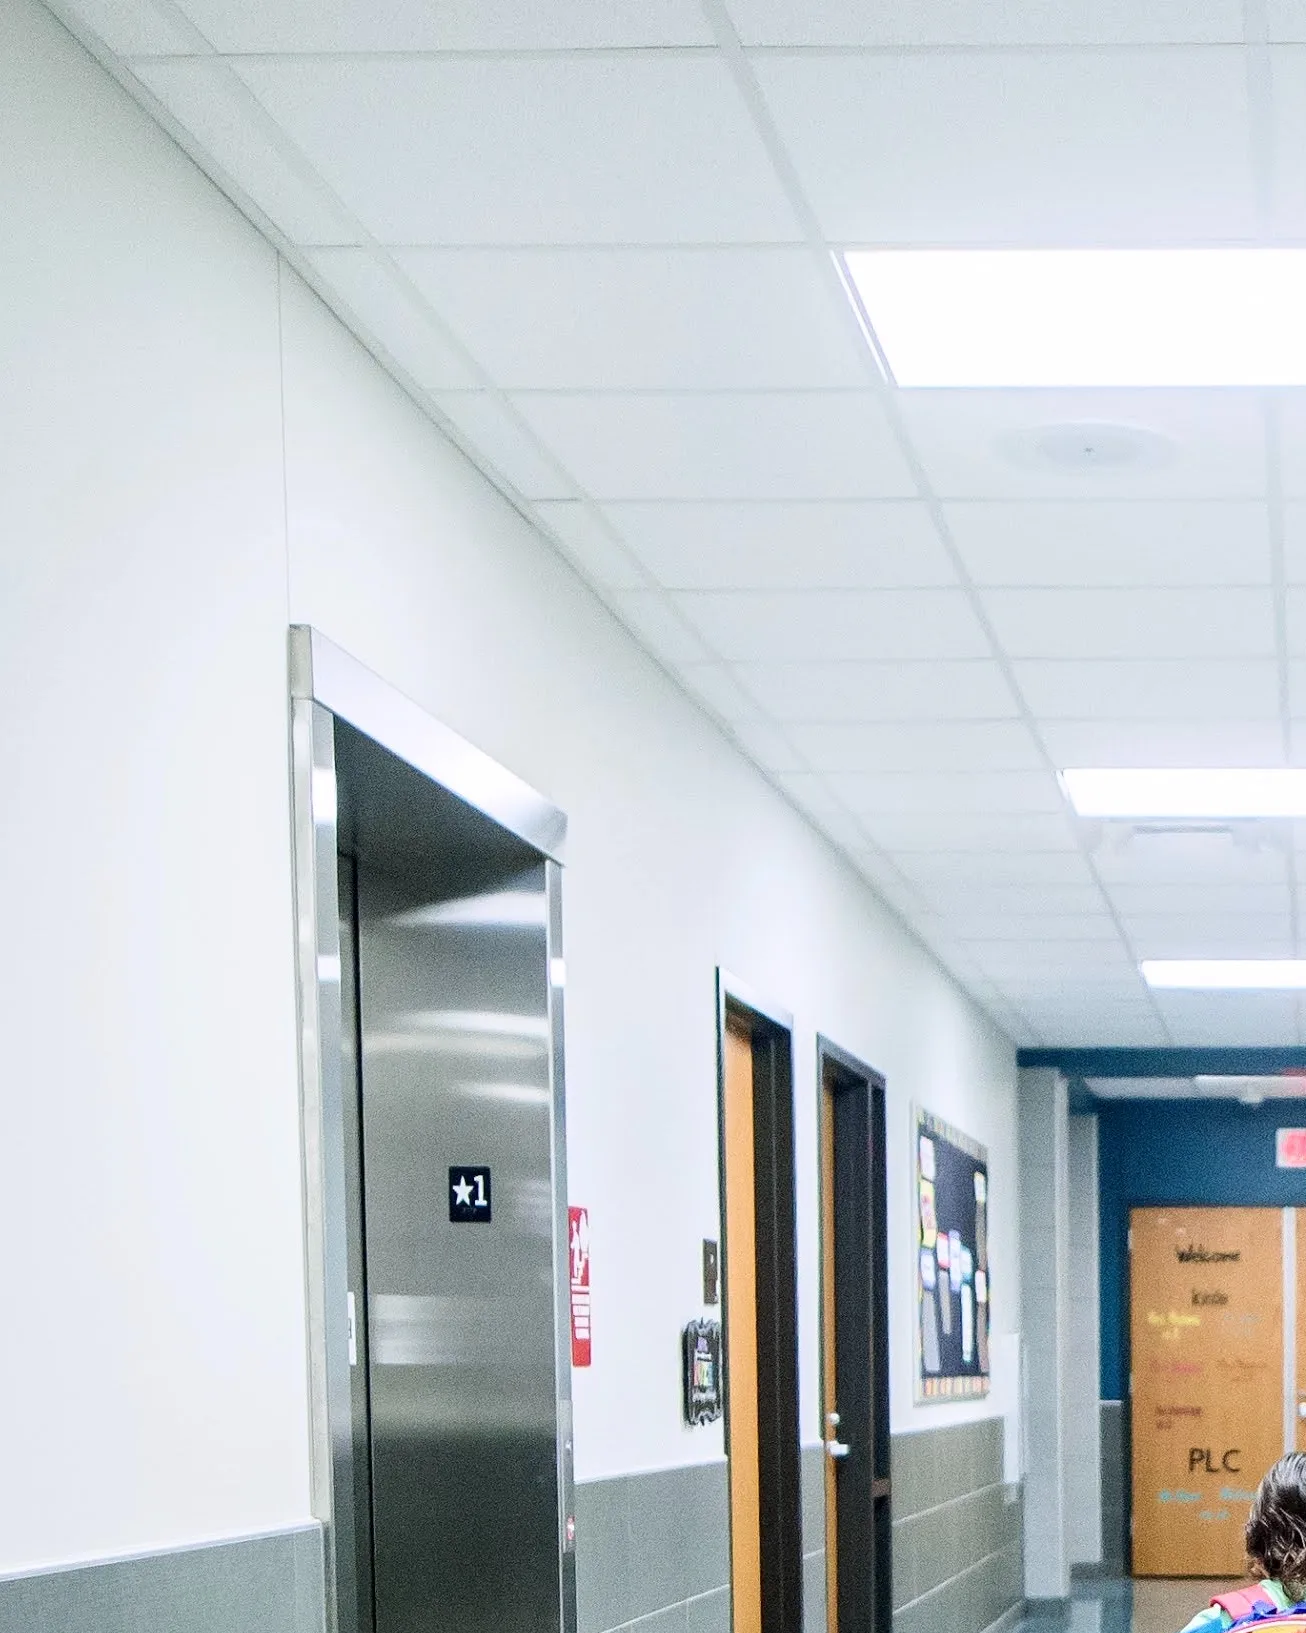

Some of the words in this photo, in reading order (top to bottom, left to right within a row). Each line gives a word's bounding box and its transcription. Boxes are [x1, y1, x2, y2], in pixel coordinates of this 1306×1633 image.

[474, 1175, 487, 1206] 1
[1176, 1243, 1240, 1263] Welcome
[1189, 1448, 1241, 1473] PLC
